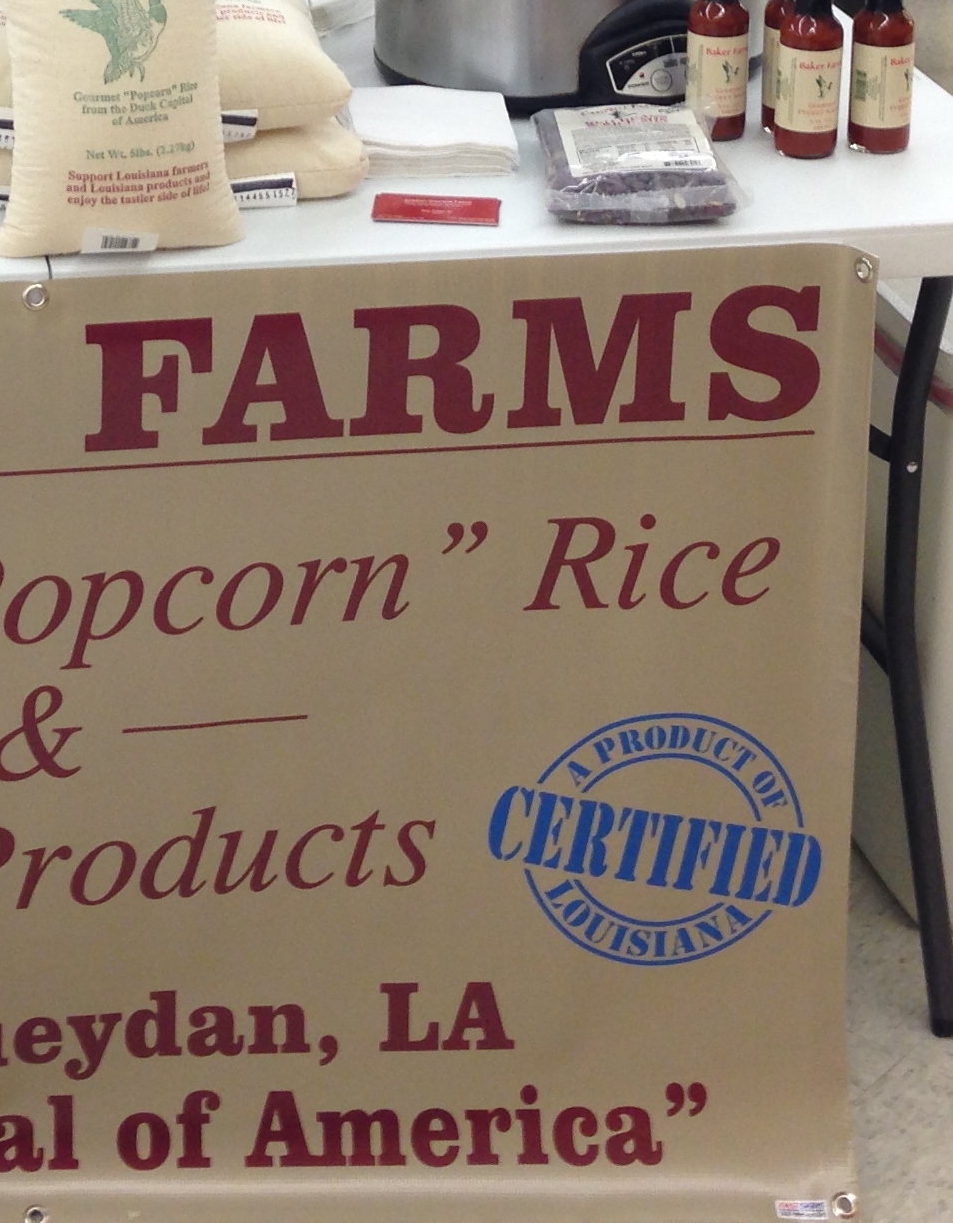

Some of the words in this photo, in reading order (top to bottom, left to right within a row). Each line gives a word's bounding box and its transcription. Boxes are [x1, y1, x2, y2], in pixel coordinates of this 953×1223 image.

[799, 61, 825, 69] Baker
[73, 91, 120, 102] Gourmet
[180, 82, 198, 93] Rice
[82, 104, 107, 114] from
[111, 104, 127, 113] the
[130, 102, 157, 113] Duck
[159, 94, 193, 109] Capital
[112, 115, 123, 126] of
[125, 113, 168, 125] America
[86, 149, 104, 160] Net
[108, 149, 127, 160] Wt.
[66, 182, 87, 193] and
[91, 182, 144, 193] Louisiana
[147, 176, 192, 193] products
[195, 170, 210, 184] and
[68, 170, 113, 183] Support
[117, 169, 169, 180] Louisiana
[172, 161, 209, 176] farmers
[67, 196, 97, 207] enjoy
[101, 195, 118, 205] the
[121, 193, 154, 204] tastier
[157, 190, 178, 202] side
[181, 188, 191, 198] of
[84, 285, 822, 453] FARMS
[523, 513, 781, 610] Rice
[566, 760, 593, 787] A
[593, 725, 757, 773] PRODUCT
[752, 770, 789, 810] OF
[487, 785, 823, 908] CERTIFIED
[544, 879, 753, 958] LOUISIANA
[379, 981, 515, 1052] LA
[116, 1089, 221, 1171] of
[244, 1082, 708, 1168] America”
